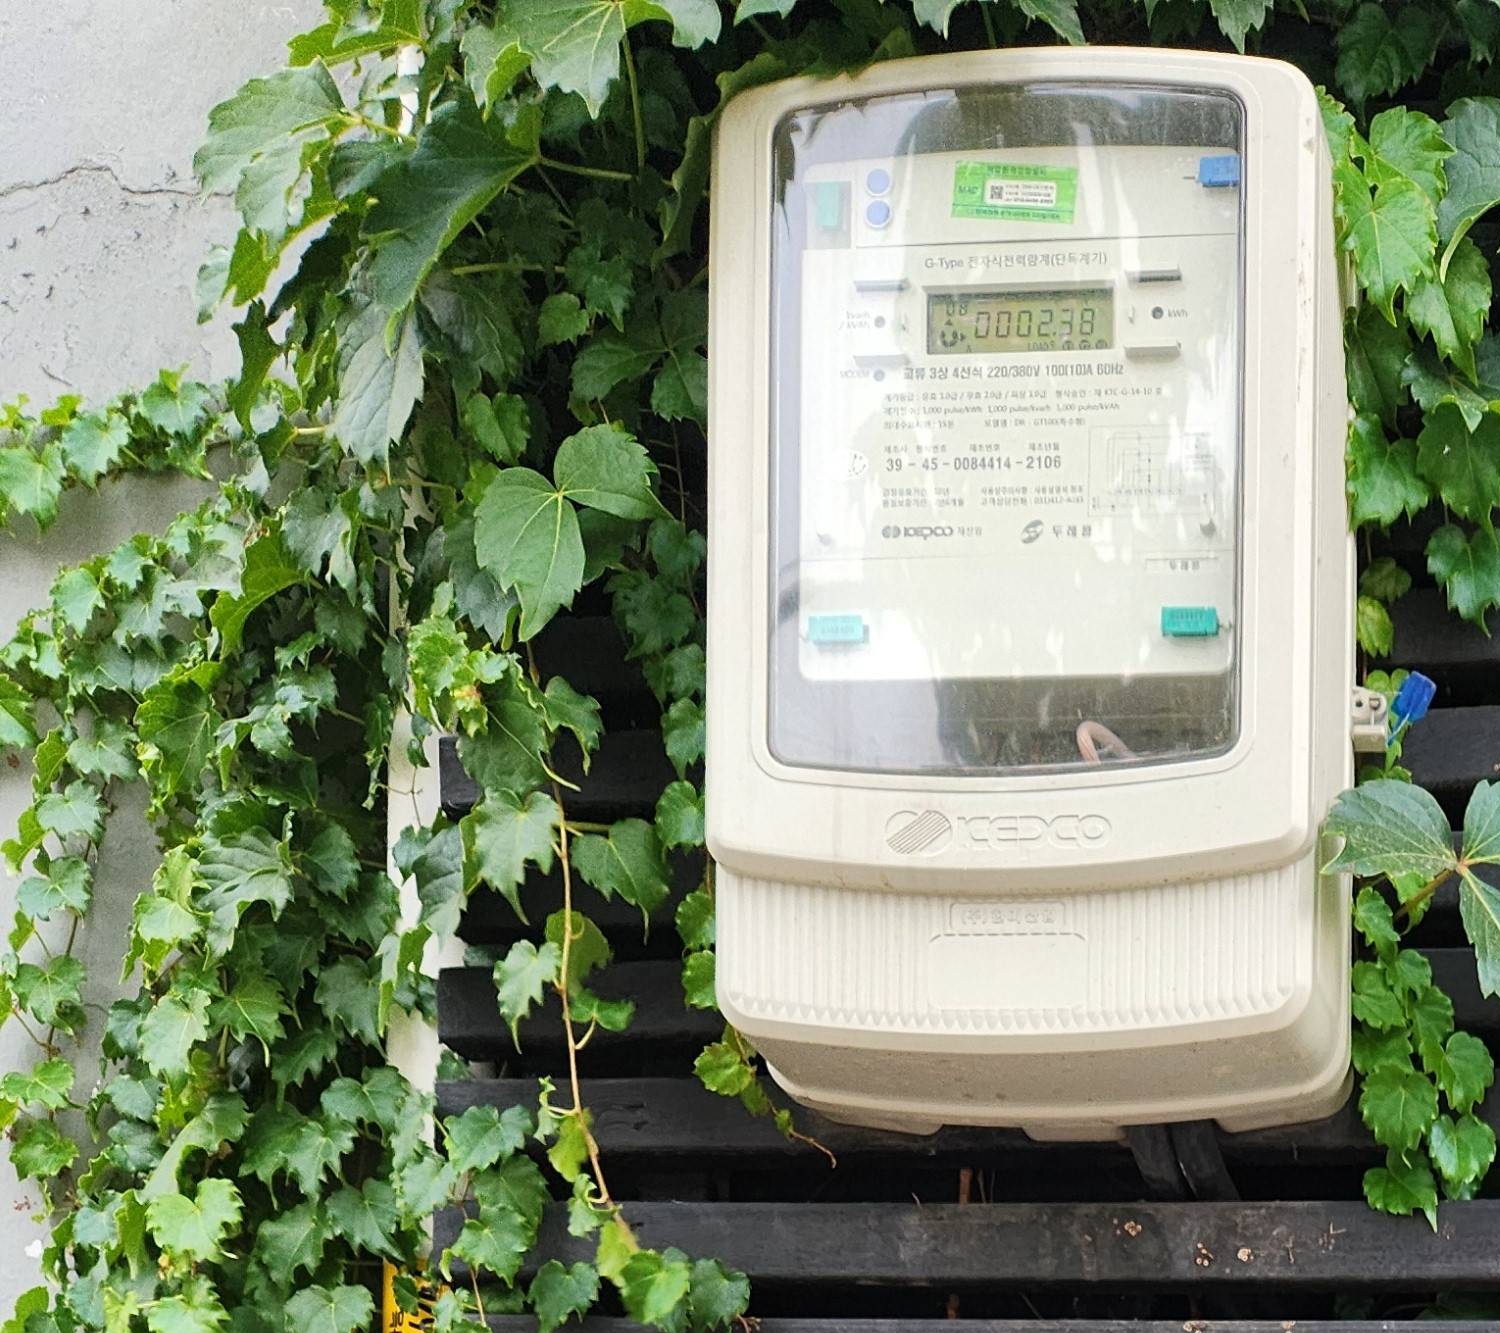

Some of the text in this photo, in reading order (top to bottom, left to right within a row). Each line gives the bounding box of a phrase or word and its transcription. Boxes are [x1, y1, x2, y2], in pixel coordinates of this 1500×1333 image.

[924, 258, 964, 270] G-Type
[974, 308, 1095, 339] 0002.38
[987, 364, 1040, 378] 220/380V
[1096, 362, 1124, 376] 60Hz
[886, 455, 1062, 472] 39 45 0084414 2106
